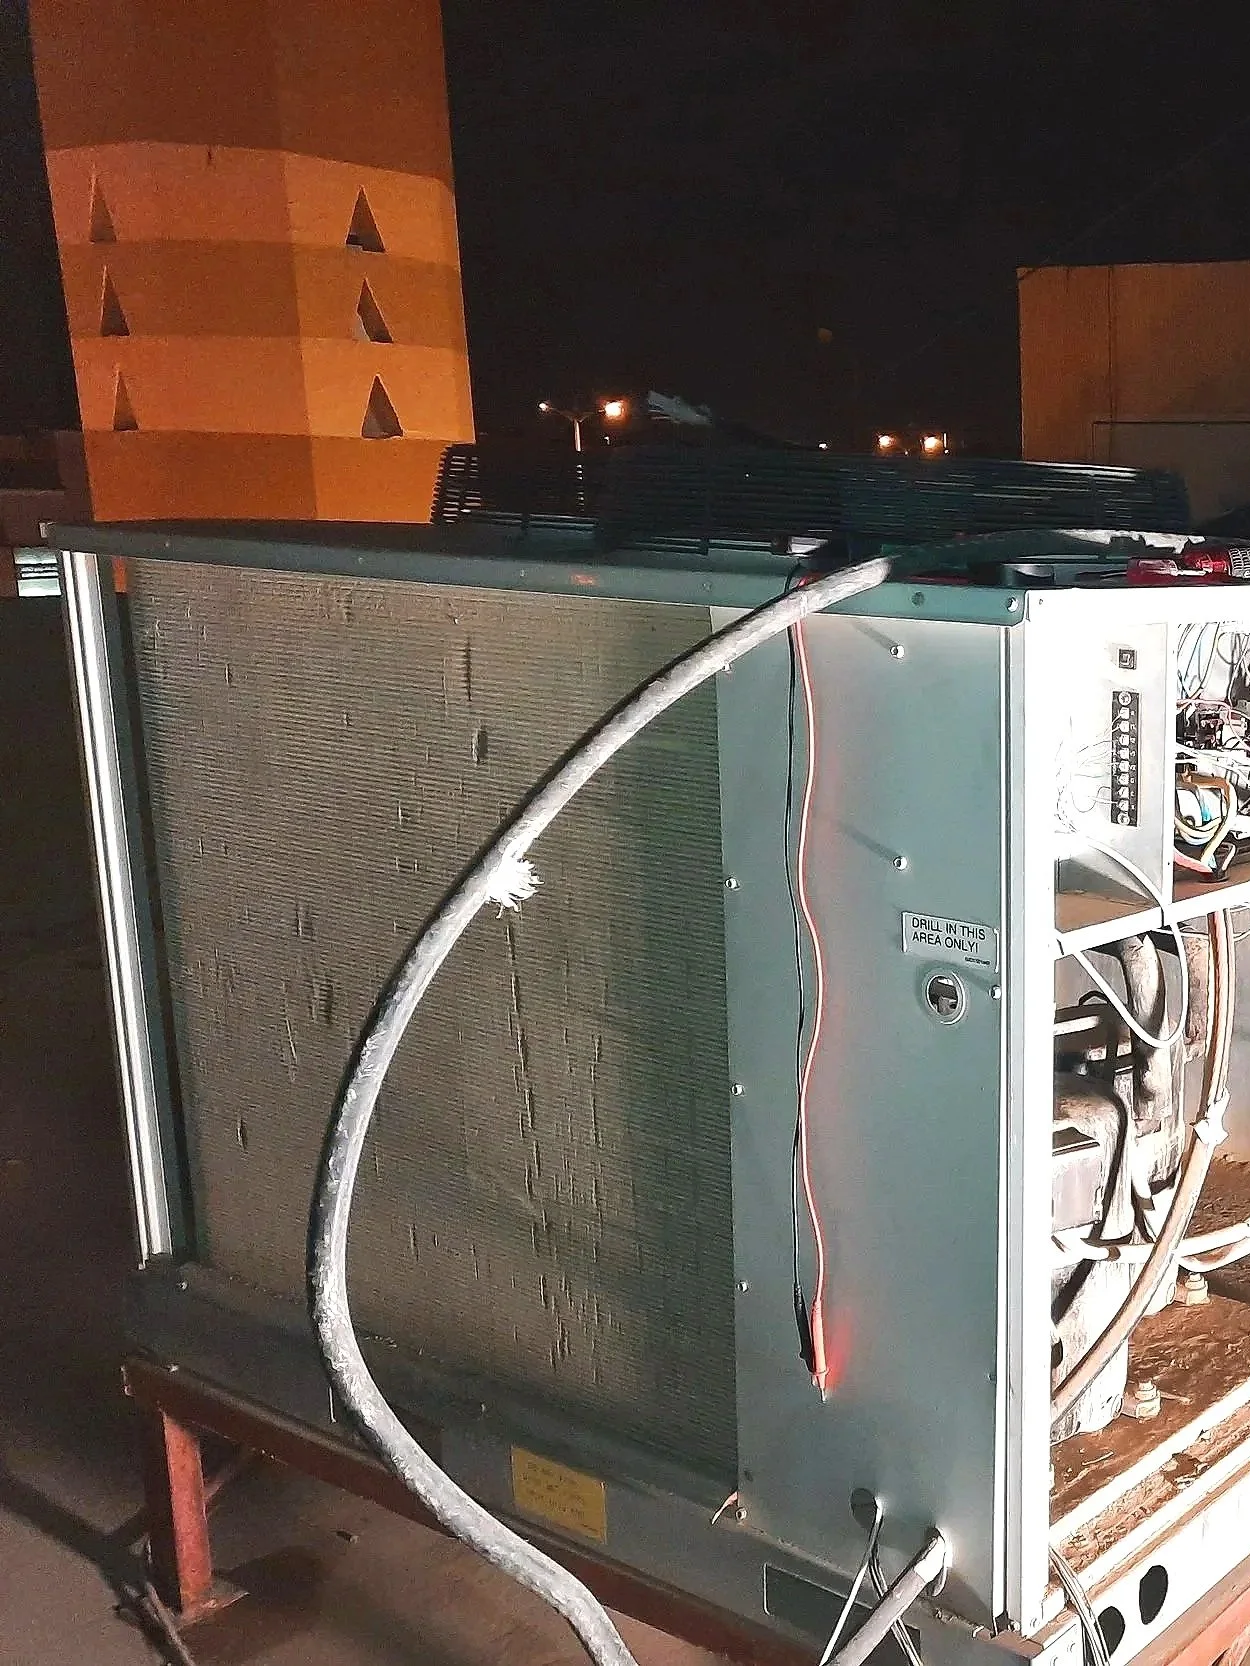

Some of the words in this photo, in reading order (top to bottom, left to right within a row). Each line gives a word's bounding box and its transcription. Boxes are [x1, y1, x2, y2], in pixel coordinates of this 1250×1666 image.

[912, 917, 942, 932] DRILL
[946, 923, 957, 935] IN
[960, 925, 986, 940] THIS
[912, 932, 941, 946] AREA
[945, 936, 978, 953] ONLY!
